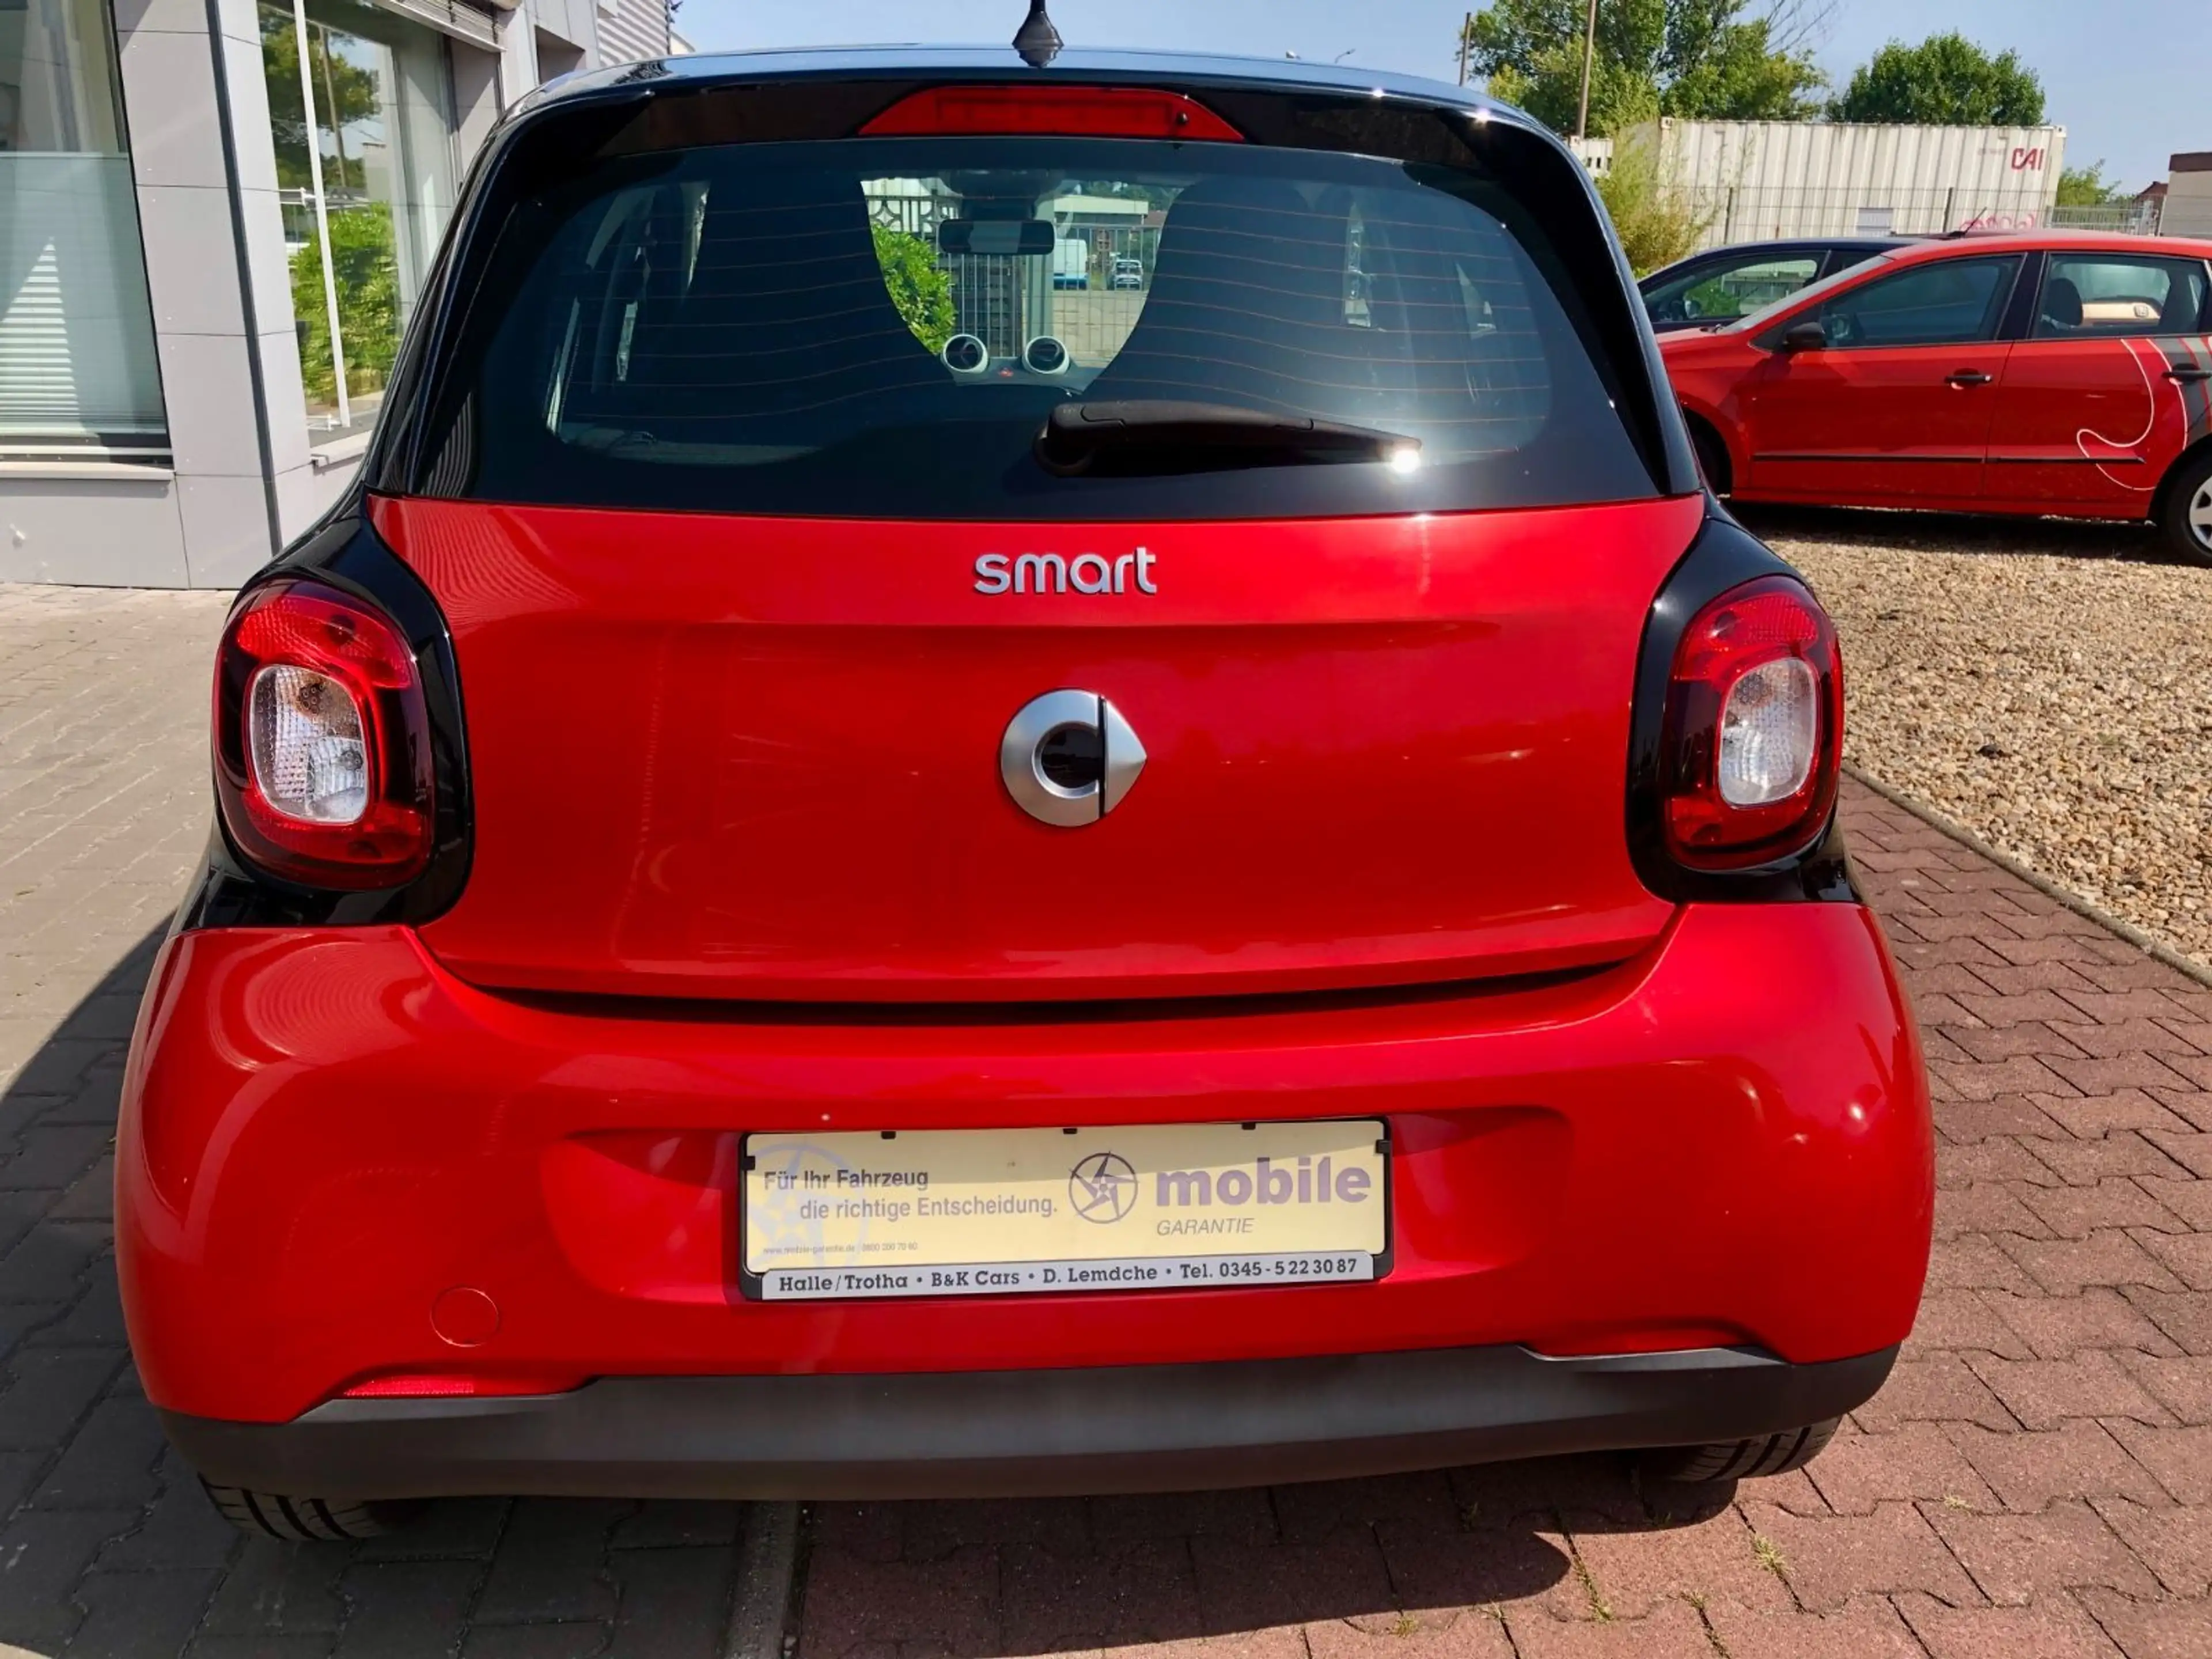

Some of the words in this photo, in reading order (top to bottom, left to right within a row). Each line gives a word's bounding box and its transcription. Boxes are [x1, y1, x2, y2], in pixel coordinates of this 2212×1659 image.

[2011, 148, 2044, 171] CAI
[974, 547, 1157, 594] smart
[764, 1171, 797, 1190] Für
[805, 1171, 830, 1189] Ihr
[837, 1169, 929, 1190] Fahrzeug
[1156, 1156, 1371, 1206] mobile
[800, 1200, 828, 1219] die
[836, 1199, 911, 1222] richtige
[918, 1195, 1058, 1217] Entscheidung.
[1156, 1218, 1255, 1236] GARANTIE
[931, 1271, 969, 1287] B&K
[975, 1270, 1020, 1286] Cars
[1043, 1268, 1061, 1283] D.
[1068, 1266, 1157, 1283] Lemdche
[1180, 1263, 1213, 1279] Tel.
